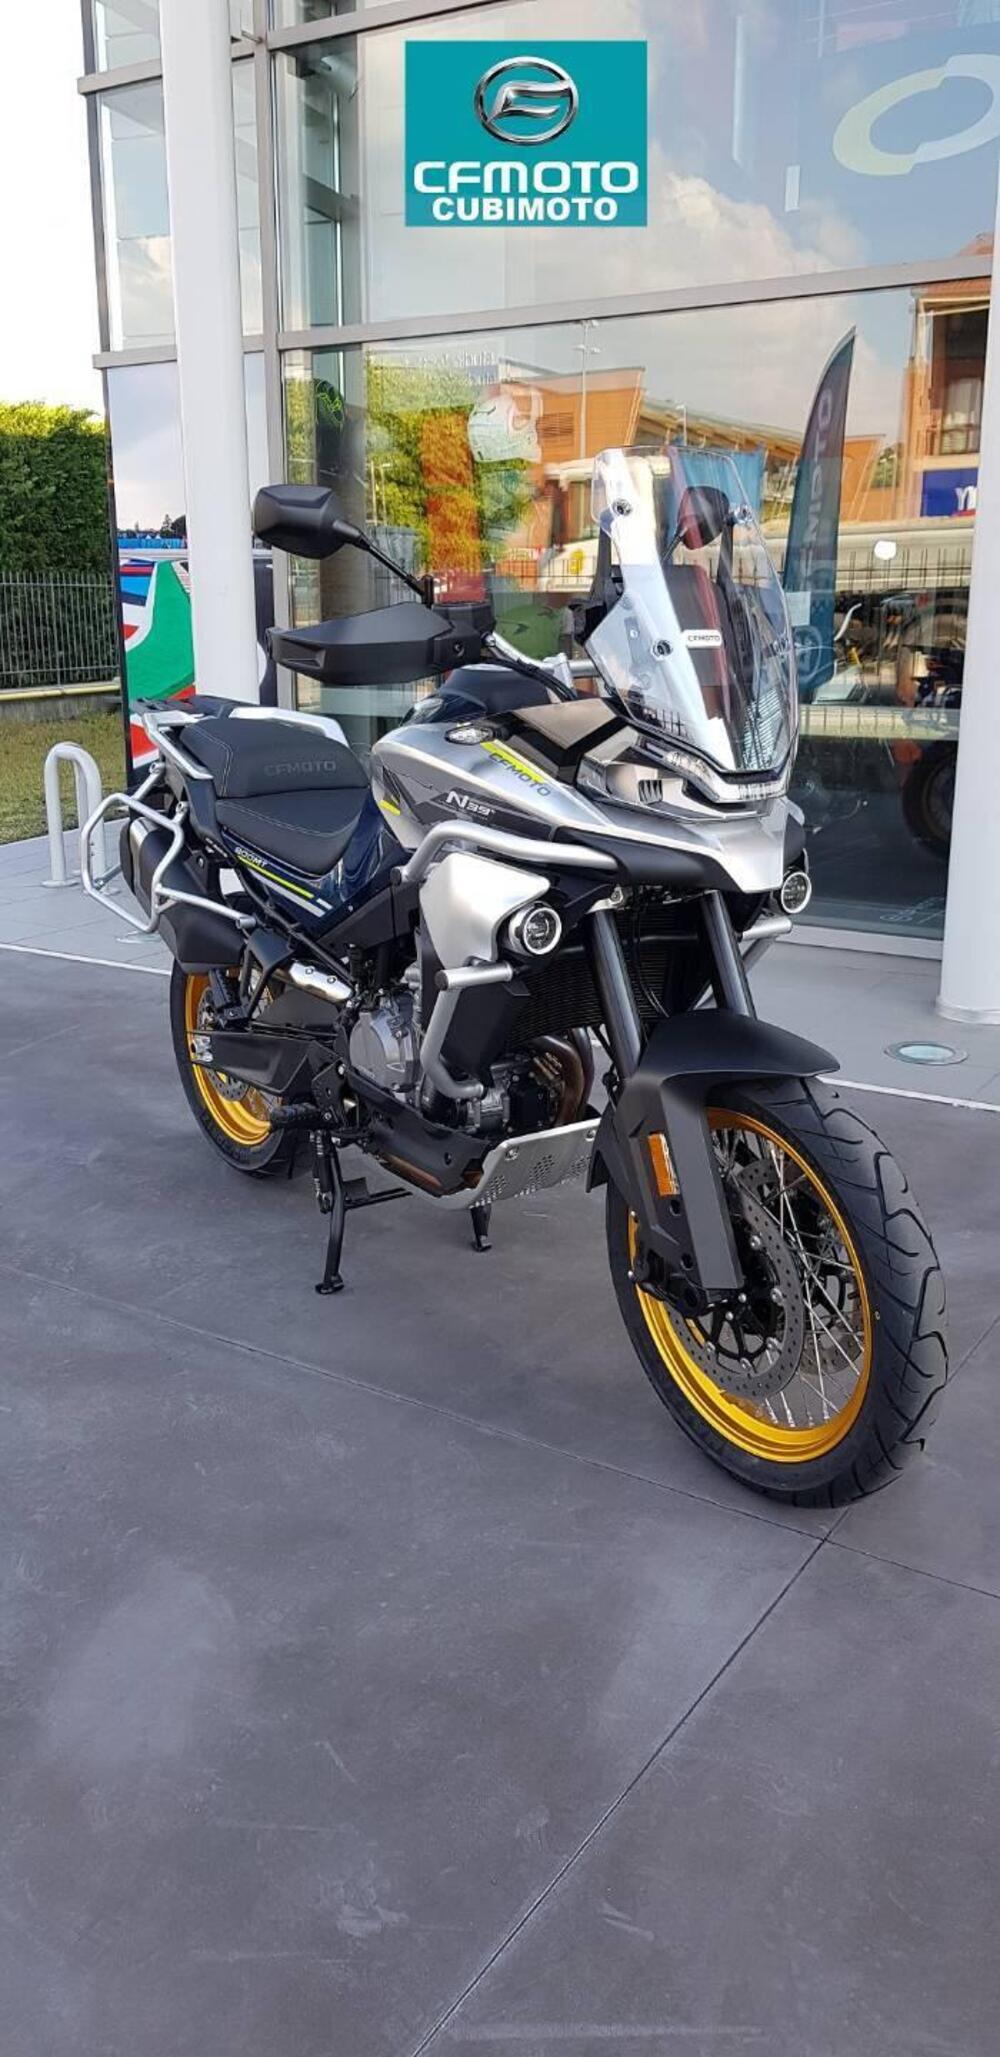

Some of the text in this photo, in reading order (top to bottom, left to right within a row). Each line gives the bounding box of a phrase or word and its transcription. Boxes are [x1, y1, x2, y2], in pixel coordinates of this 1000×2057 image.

[265, 760, 336, 776] CFMOTO
[489, 752, 551, 797] CFMOTO
[234, 846, 268, 868] 800MT
